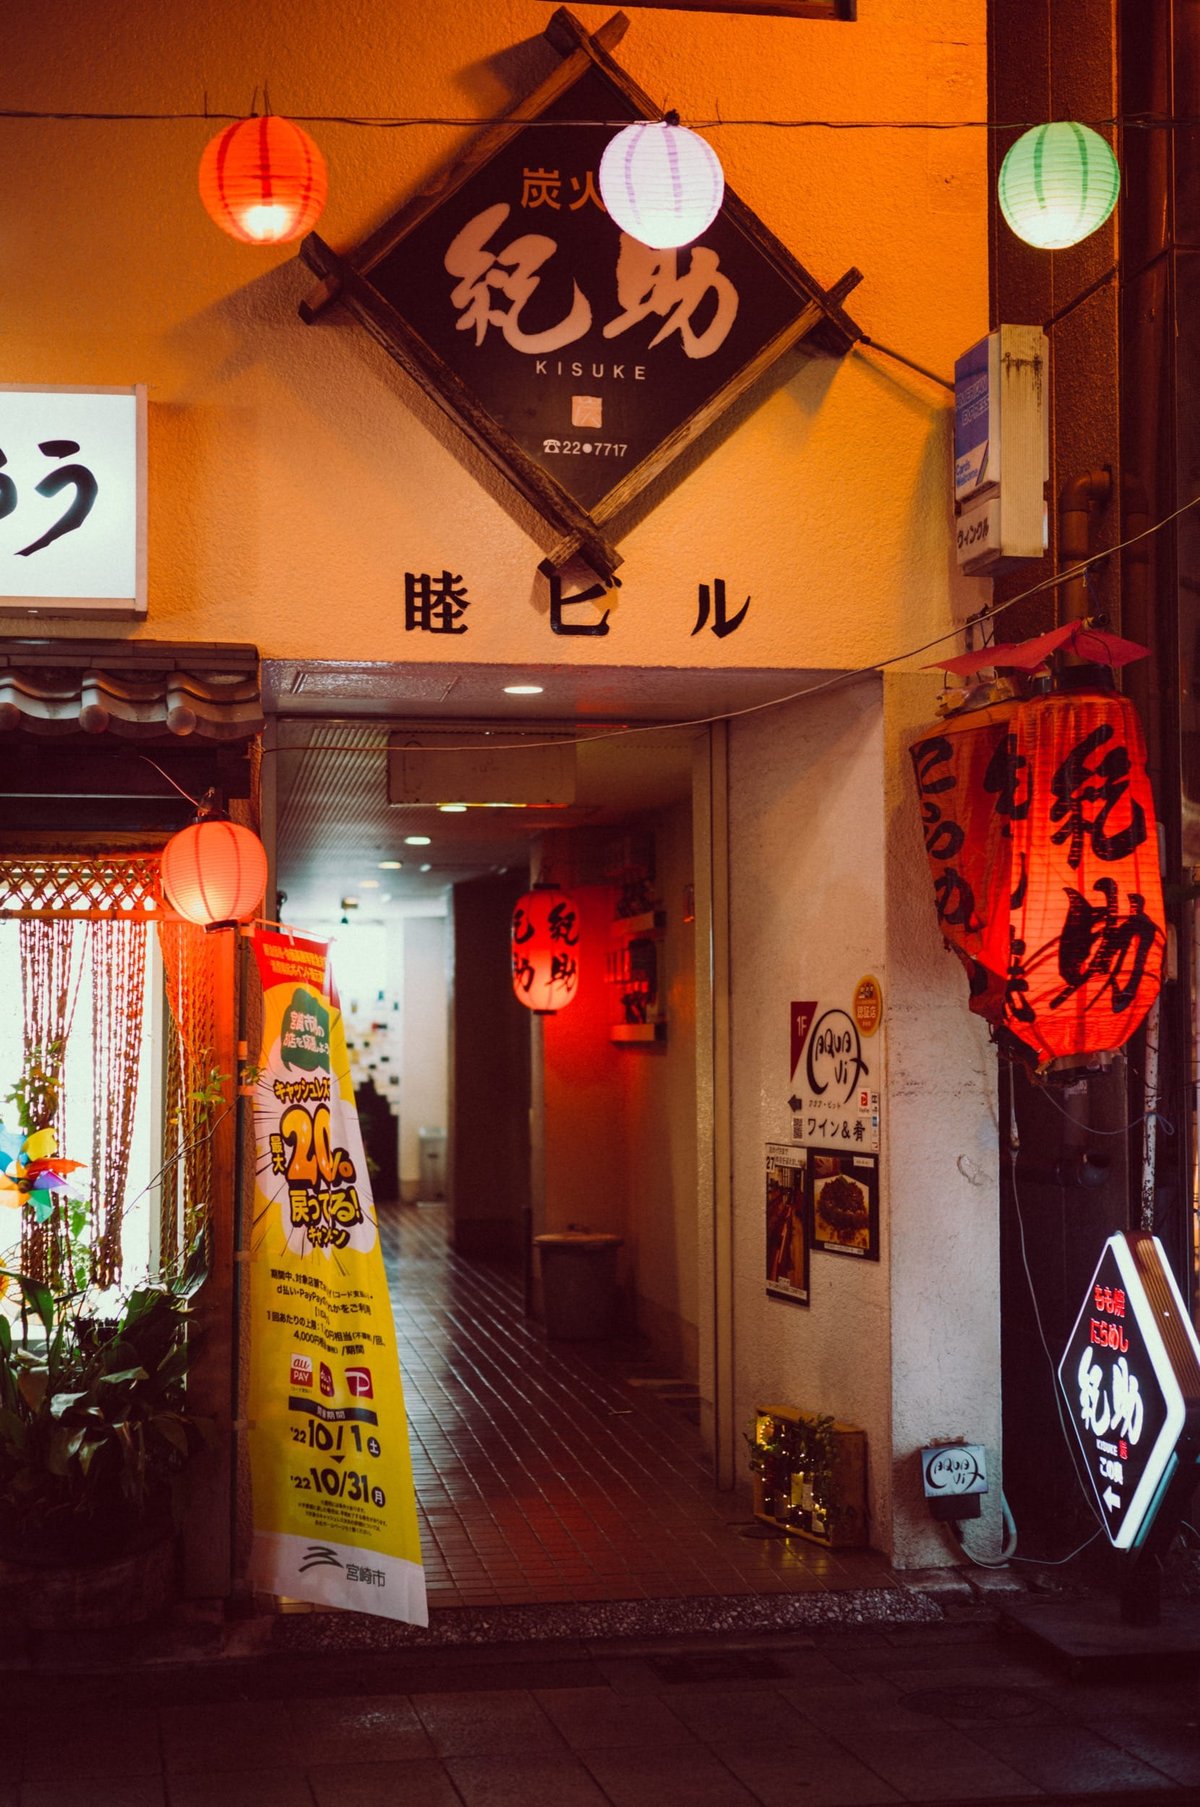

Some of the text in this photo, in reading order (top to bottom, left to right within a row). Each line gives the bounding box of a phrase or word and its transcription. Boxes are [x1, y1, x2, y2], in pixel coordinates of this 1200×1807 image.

[535, 360, 647, 381] KISUKE
[0, 440, 99, 557] う
[269, 1132, 286, 1176] 最大
[293, 1370, 310, 1383] PAY
[345, 1563, 386, 1587] 宮崎市
